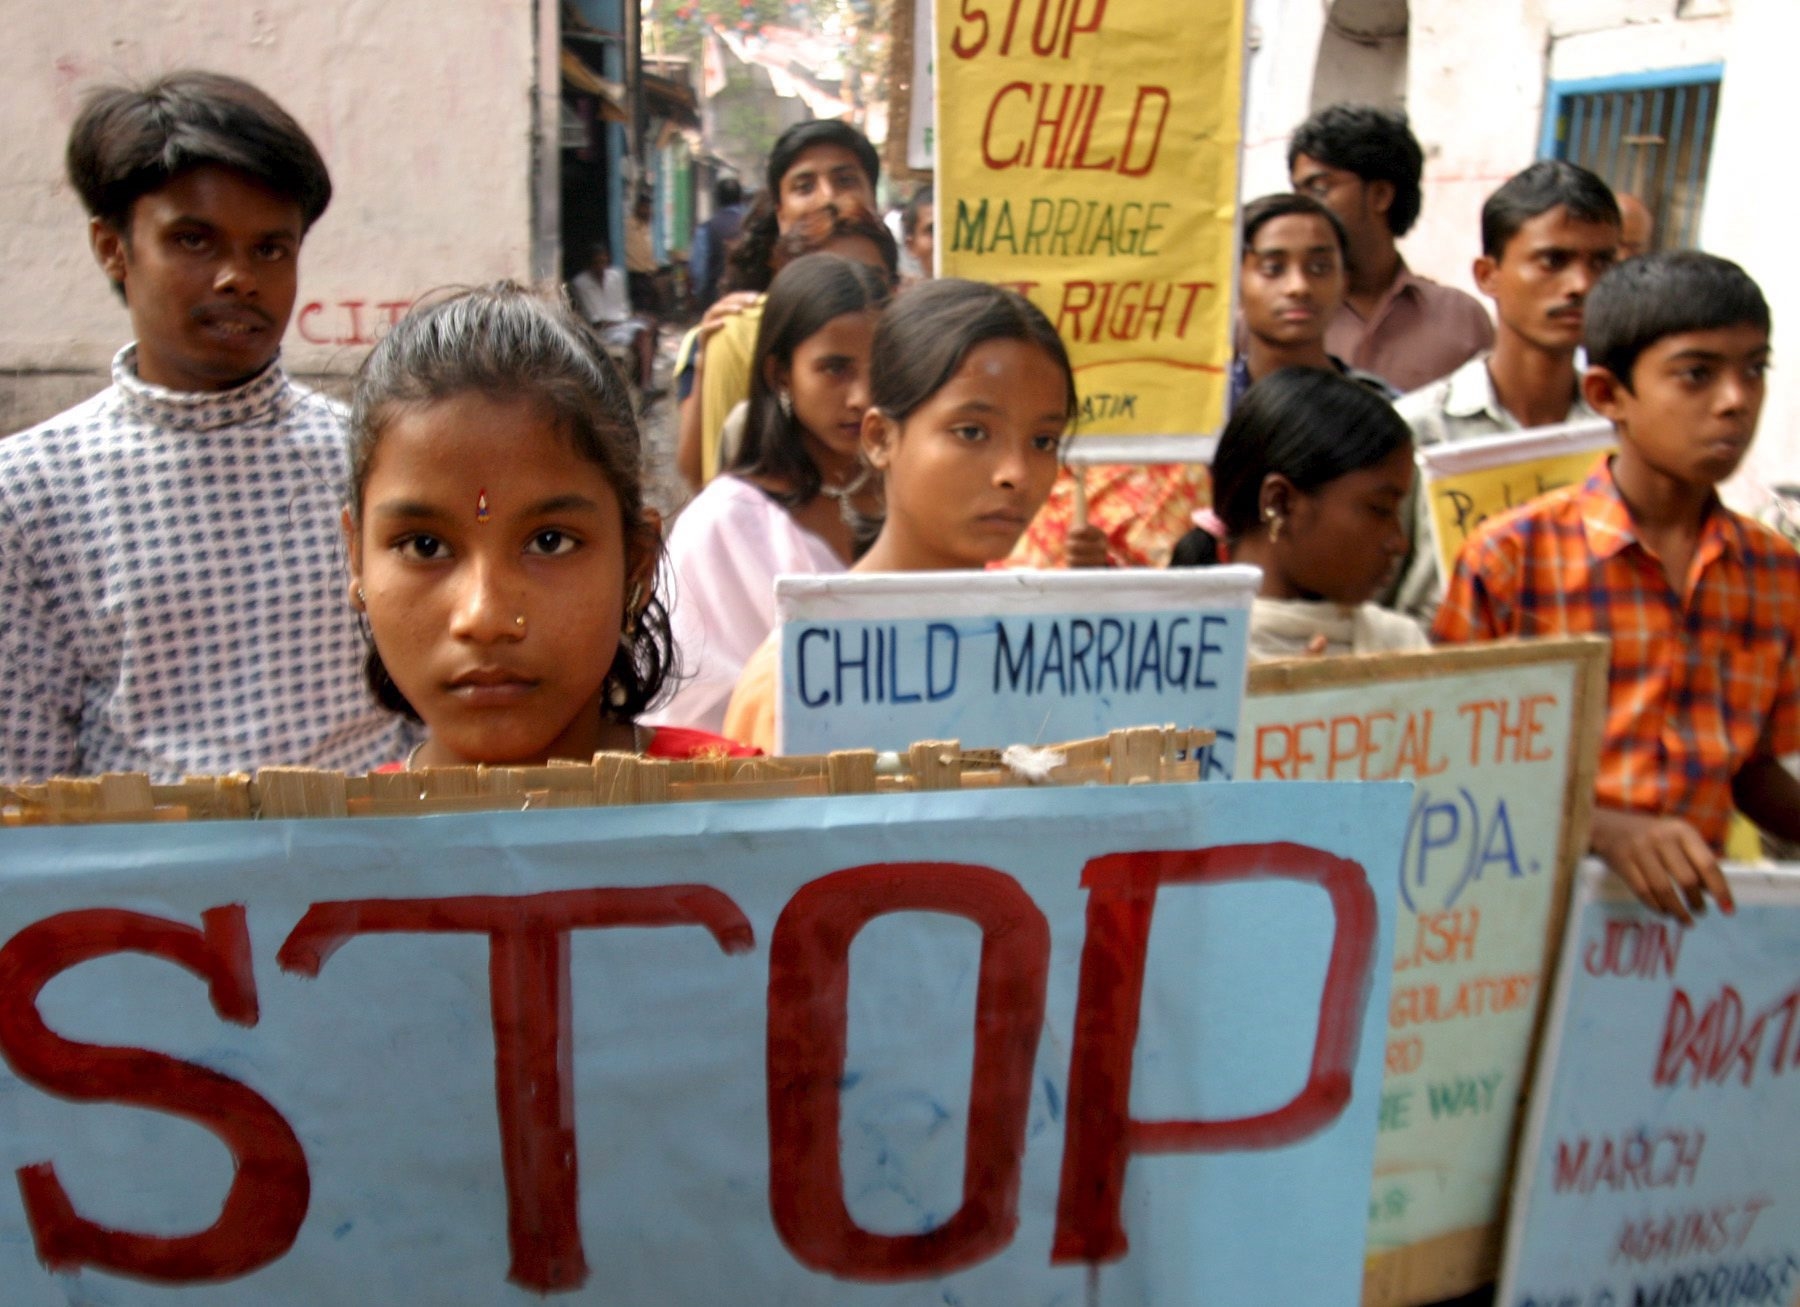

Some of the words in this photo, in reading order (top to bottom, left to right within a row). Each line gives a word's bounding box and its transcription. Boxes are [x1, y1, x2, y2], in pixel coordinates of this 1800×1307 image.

[981, 81, 1171, 177] CHILD
[951, 198, 1171, 257] MARRIAGE
[1056, 281, 1215, 343] RIGHT
[1081, 392, 1138, 421] ATIK
[798, 622, 960, 707] CHILD
[993, 616, 1228, 696] MARRIAGE
[1253, 708, 1449, 780] REPEAL
[1458, 693, 1558, 767] THE
[1583, 918, 1685, 980] JOIN
[0, 840, 1379, 1290] STOP
[1429, 1069, 1503, 1121] WAY
[1553, 1127, 1706, 1194] MARCH
